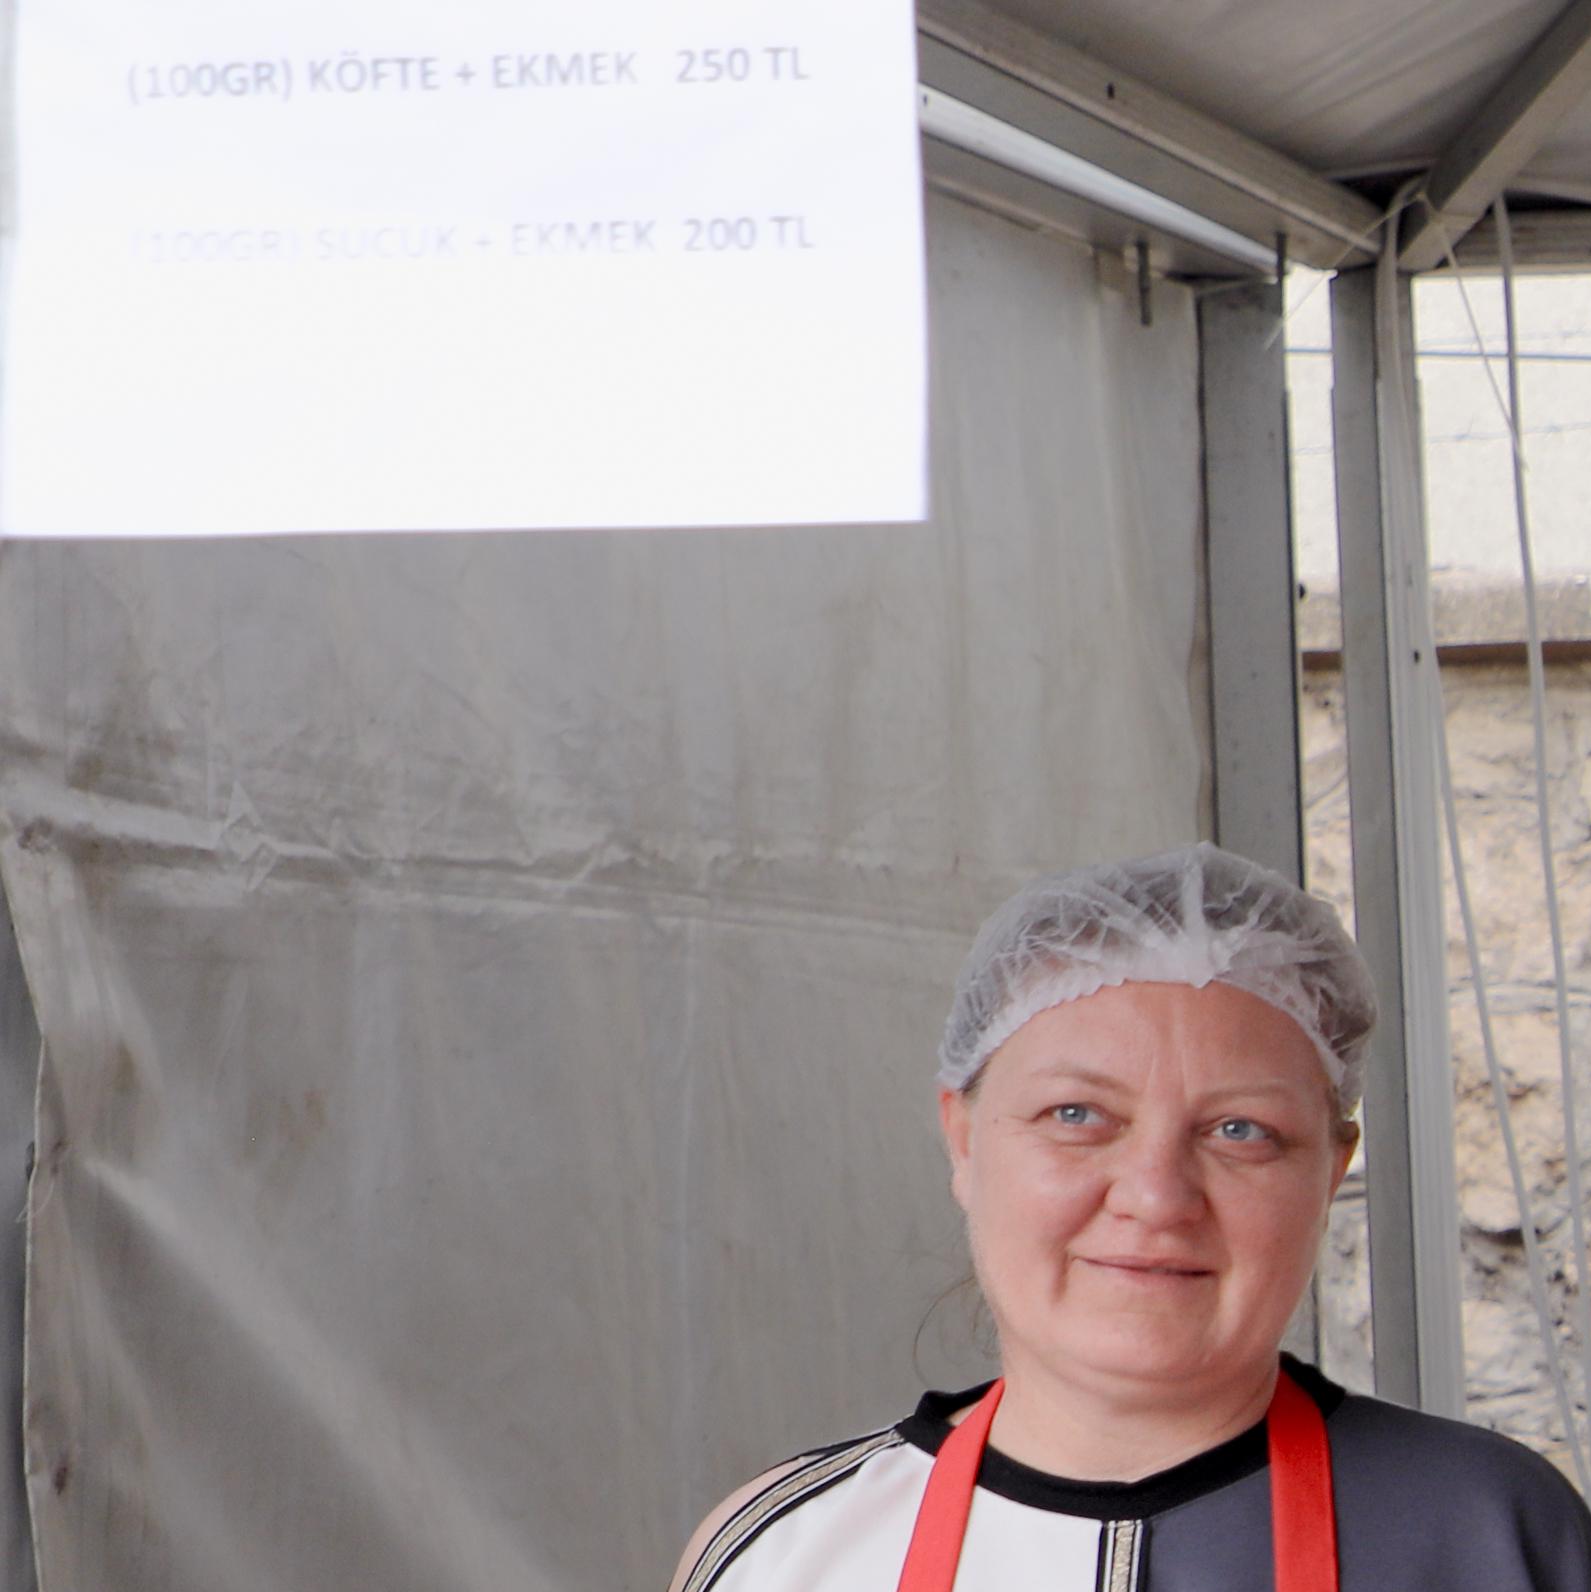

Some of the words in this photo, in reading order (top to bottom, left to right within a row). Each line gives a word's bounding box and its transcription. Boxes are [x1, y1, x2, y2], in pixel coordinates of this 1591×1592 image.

[127, 59, 293, 106] (100GR)
[307, 49, 440, 93] KÖFTE
[491, 52, 638, 88] EKMEK
[675, 48, 750, 83] 250
[763, 46, 811, 82] TL
[317, 225, 459, 260] SUCUK
[511, 220, 655, 256] EKMEK
[683, 217, 756, 252] 200
[768, 215, 815, 250] TL
